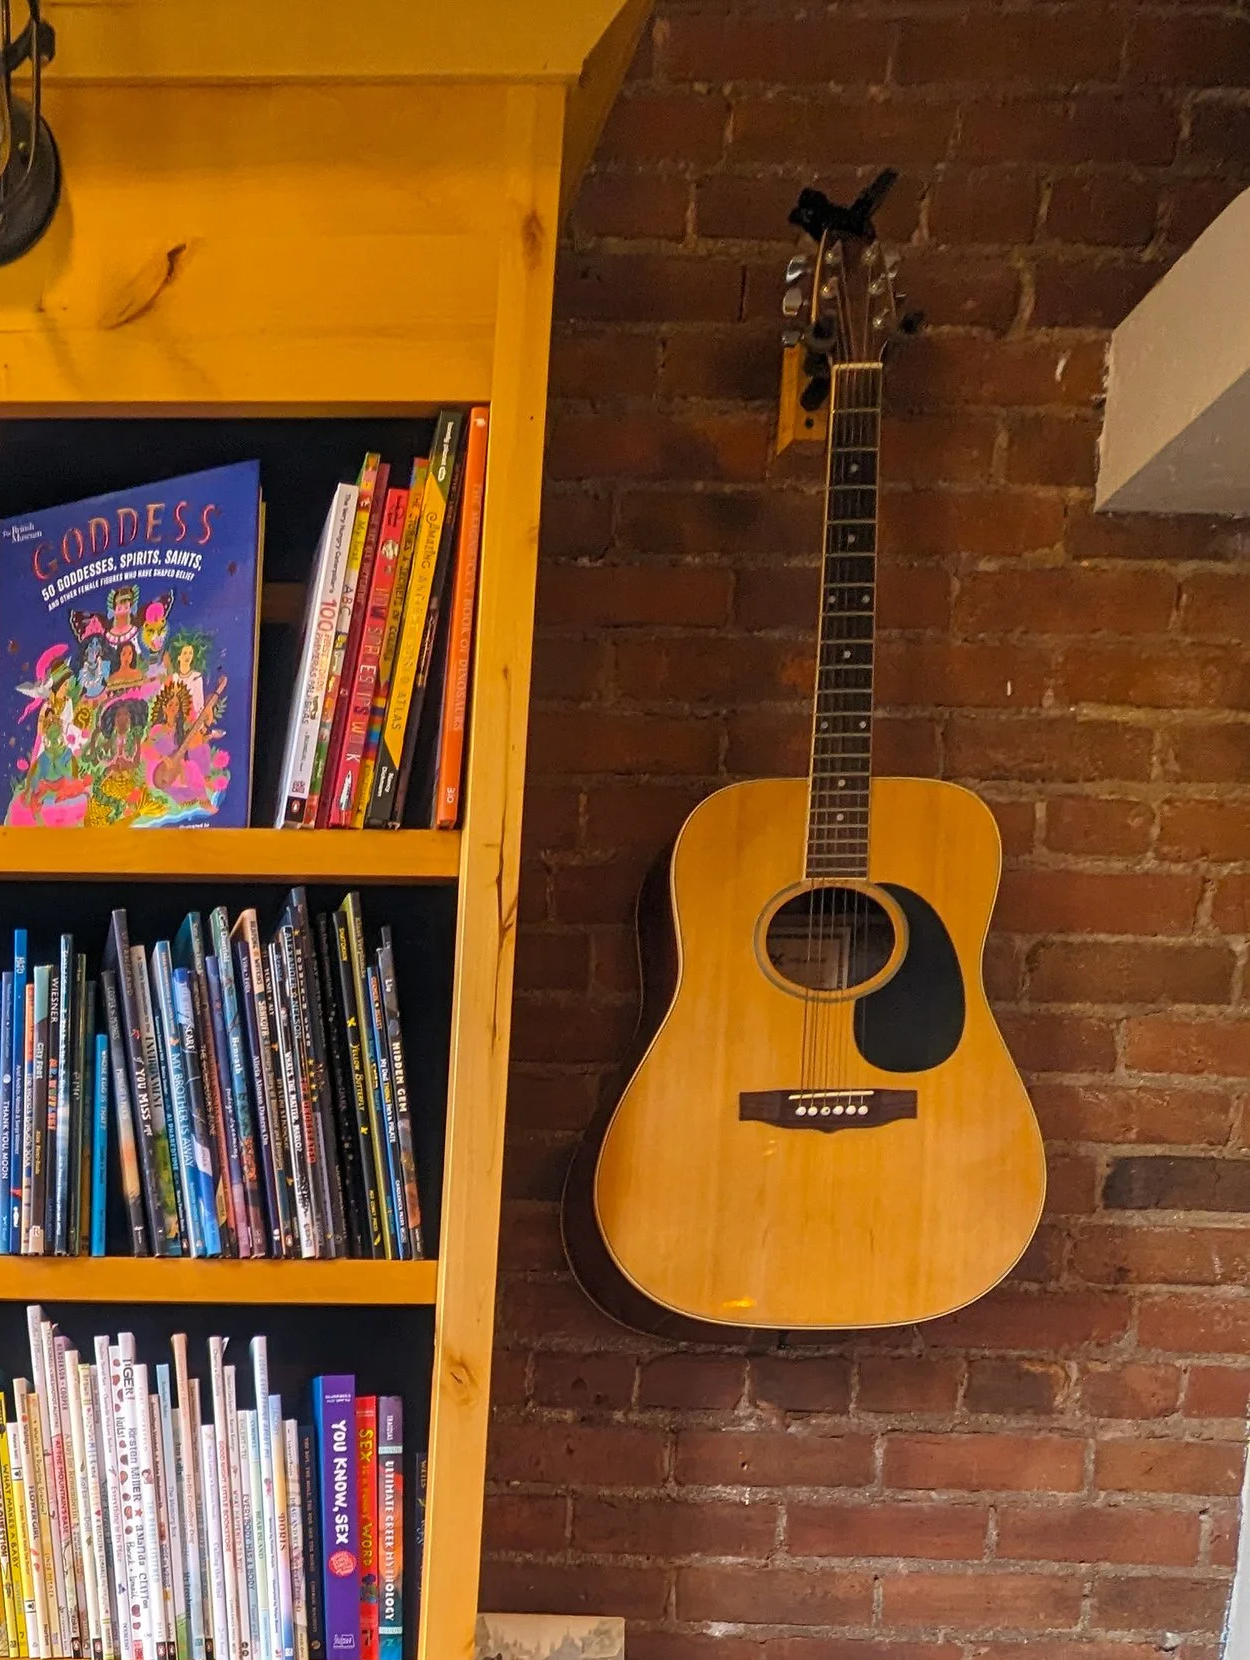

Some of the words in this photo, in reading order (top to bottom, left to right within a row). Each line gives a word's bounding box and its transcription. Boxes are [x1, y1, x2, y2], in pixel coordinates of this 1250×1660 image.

[33, 502, 220, 580] GODDESS
[42, 584, 54, 601] 50
[56, 557, 116, 594] GODDESSES,
[121, 552, 162, 574] SPIRITS,
[165, 549, 202, 570] SAINTS,
[316, 599, 338, 632] 100
[392, 1042, 404, 1084] HIDDEN
[1, 1101, 9, 1131] THANK
[396, 1087, 407, 1112] GEM
[0, 1133, 9, 1152] YOU,
[332, 1421, 346, 1454] YOU
[360, 1429, 373, 1462] SEX
[333, 1458, 346, 1512] KNOW,
[384, 1461, 394, 1511] ULTIMATE
[335, 1514, 348, 1544] SEX
[362, 1523, 373, 1566] WORD
[384, 1515, 395, 1548] GREEK
[384, 1551, 395, 1620] MYTHOLOGY
